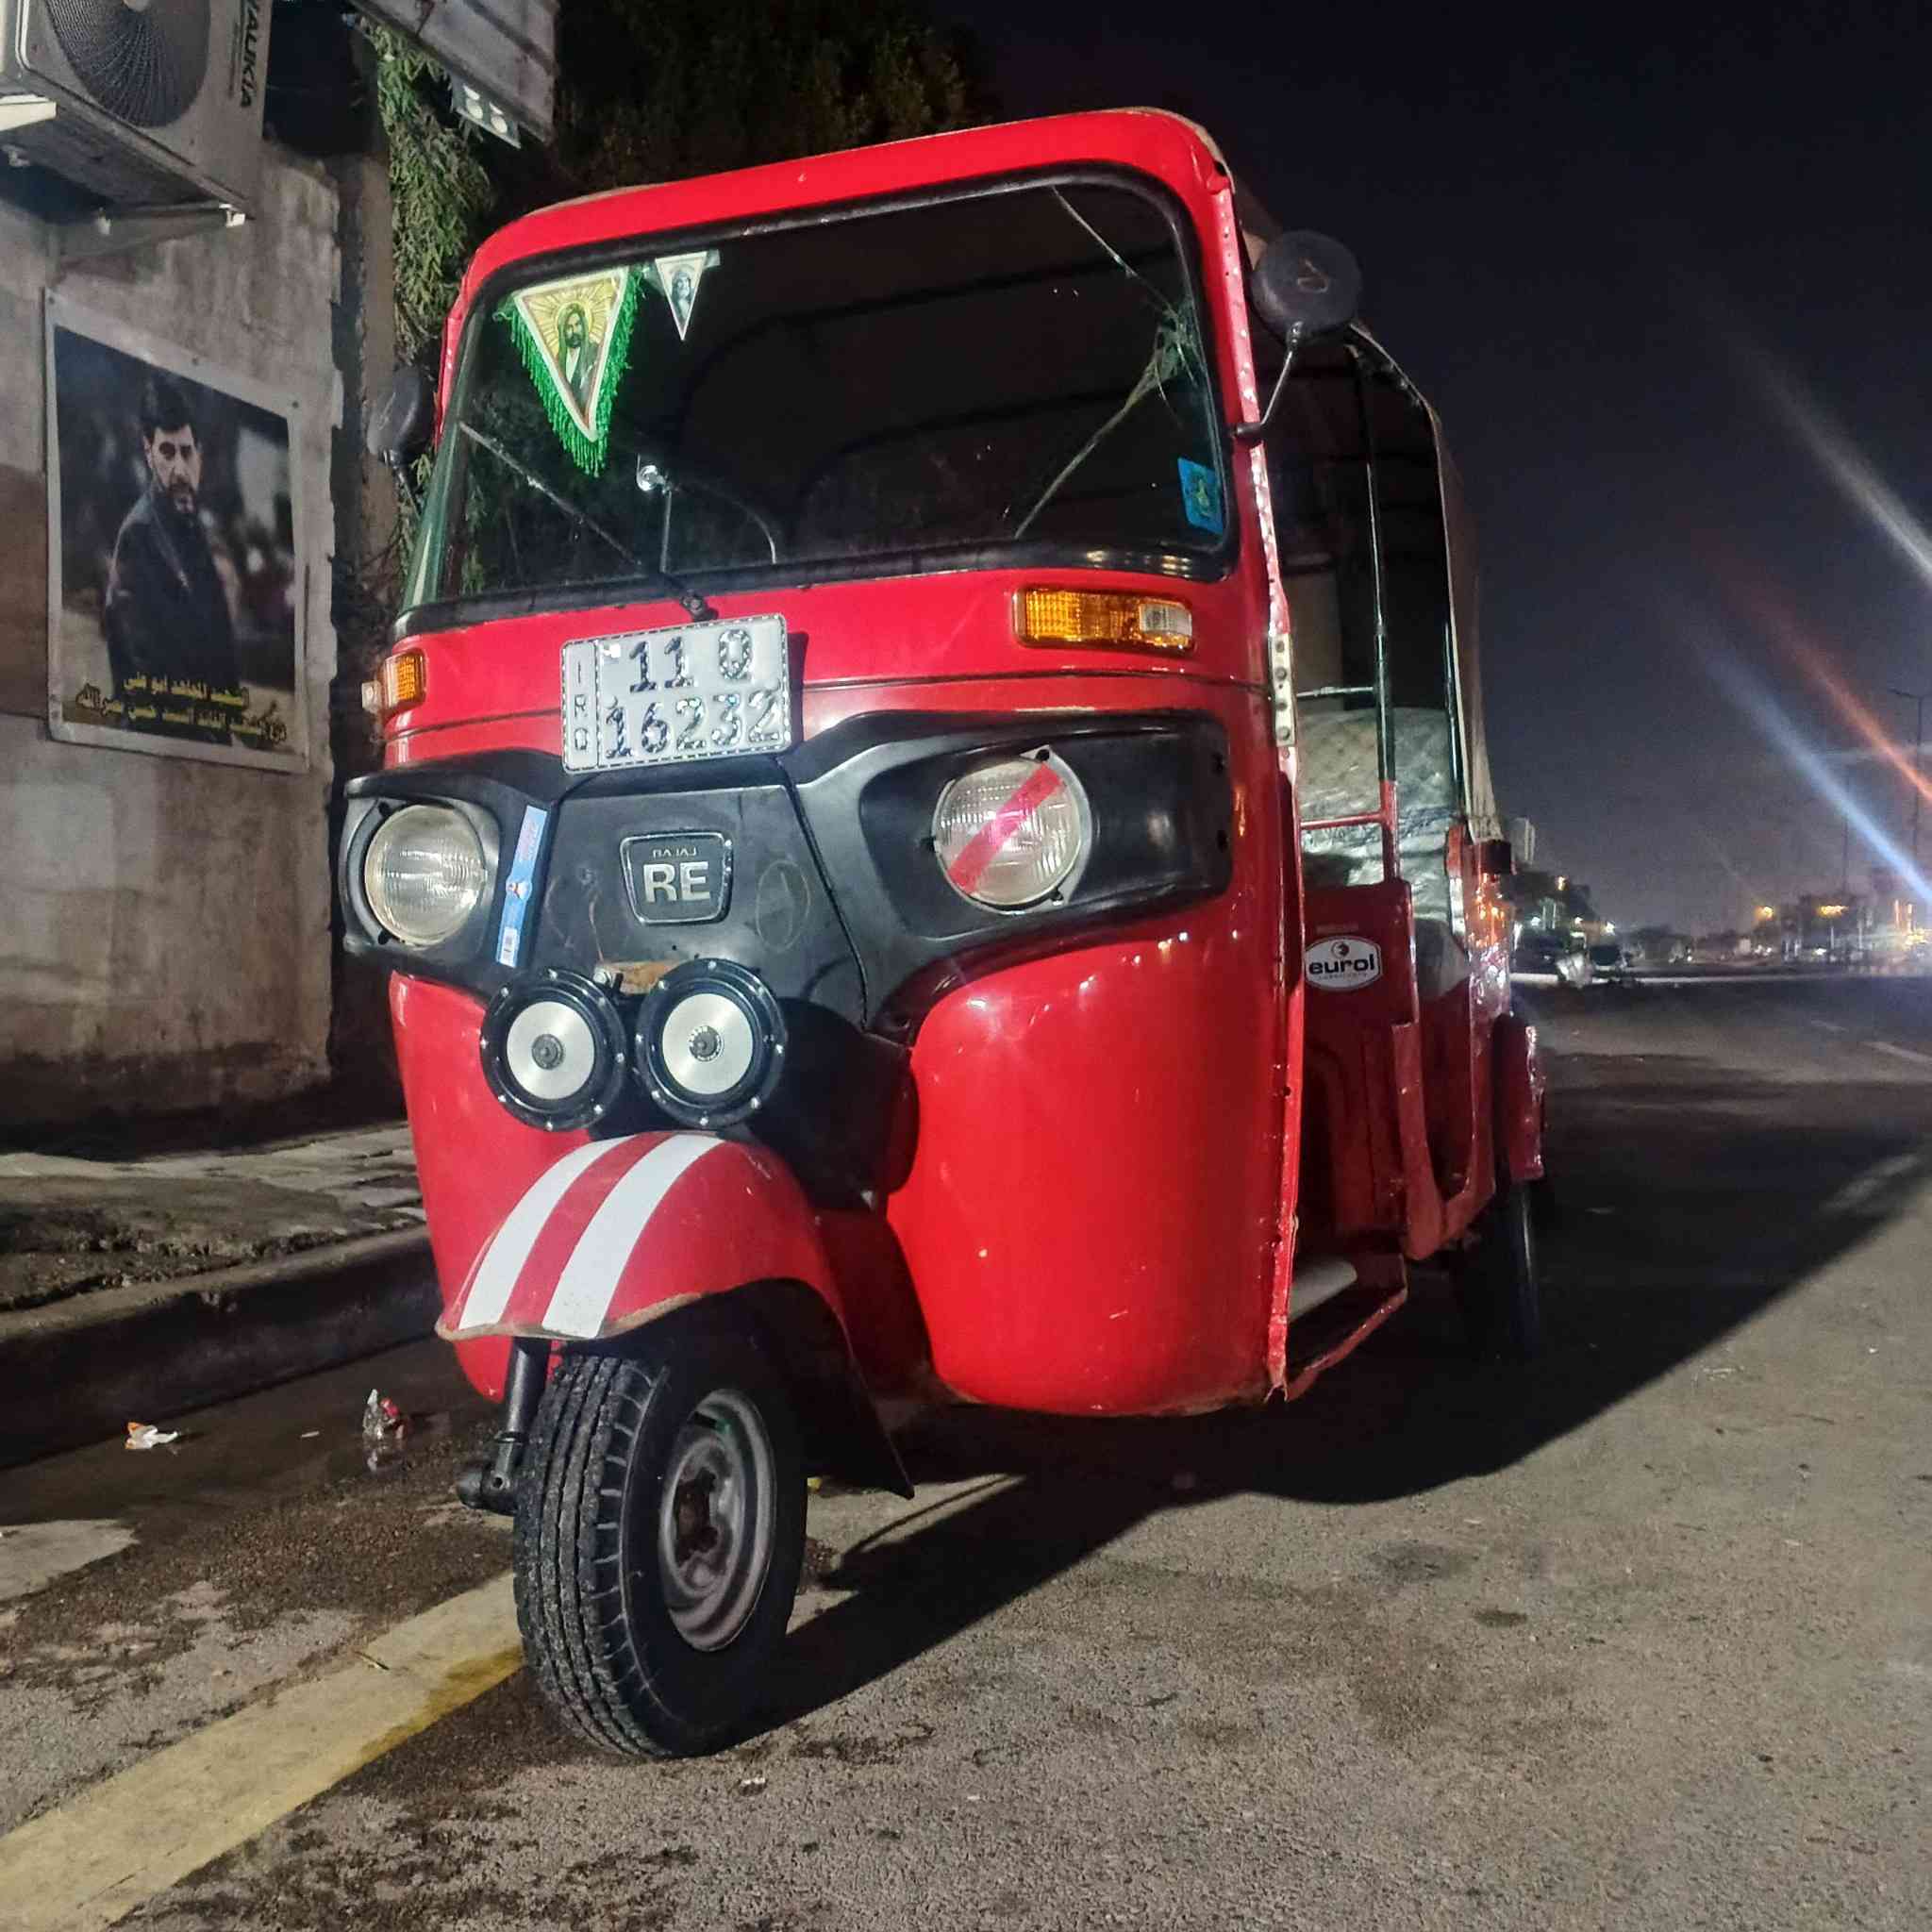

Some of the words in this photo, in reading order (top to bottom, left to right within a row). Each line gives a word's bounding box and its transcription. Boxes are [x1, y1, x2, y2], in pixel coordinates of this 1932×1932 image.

[629, 636, 698, 692] 11
[606, 689, 782, 758] 16232
[642, 861, 710, 903] RE
[1308, 954, 1375, 974] eurol
